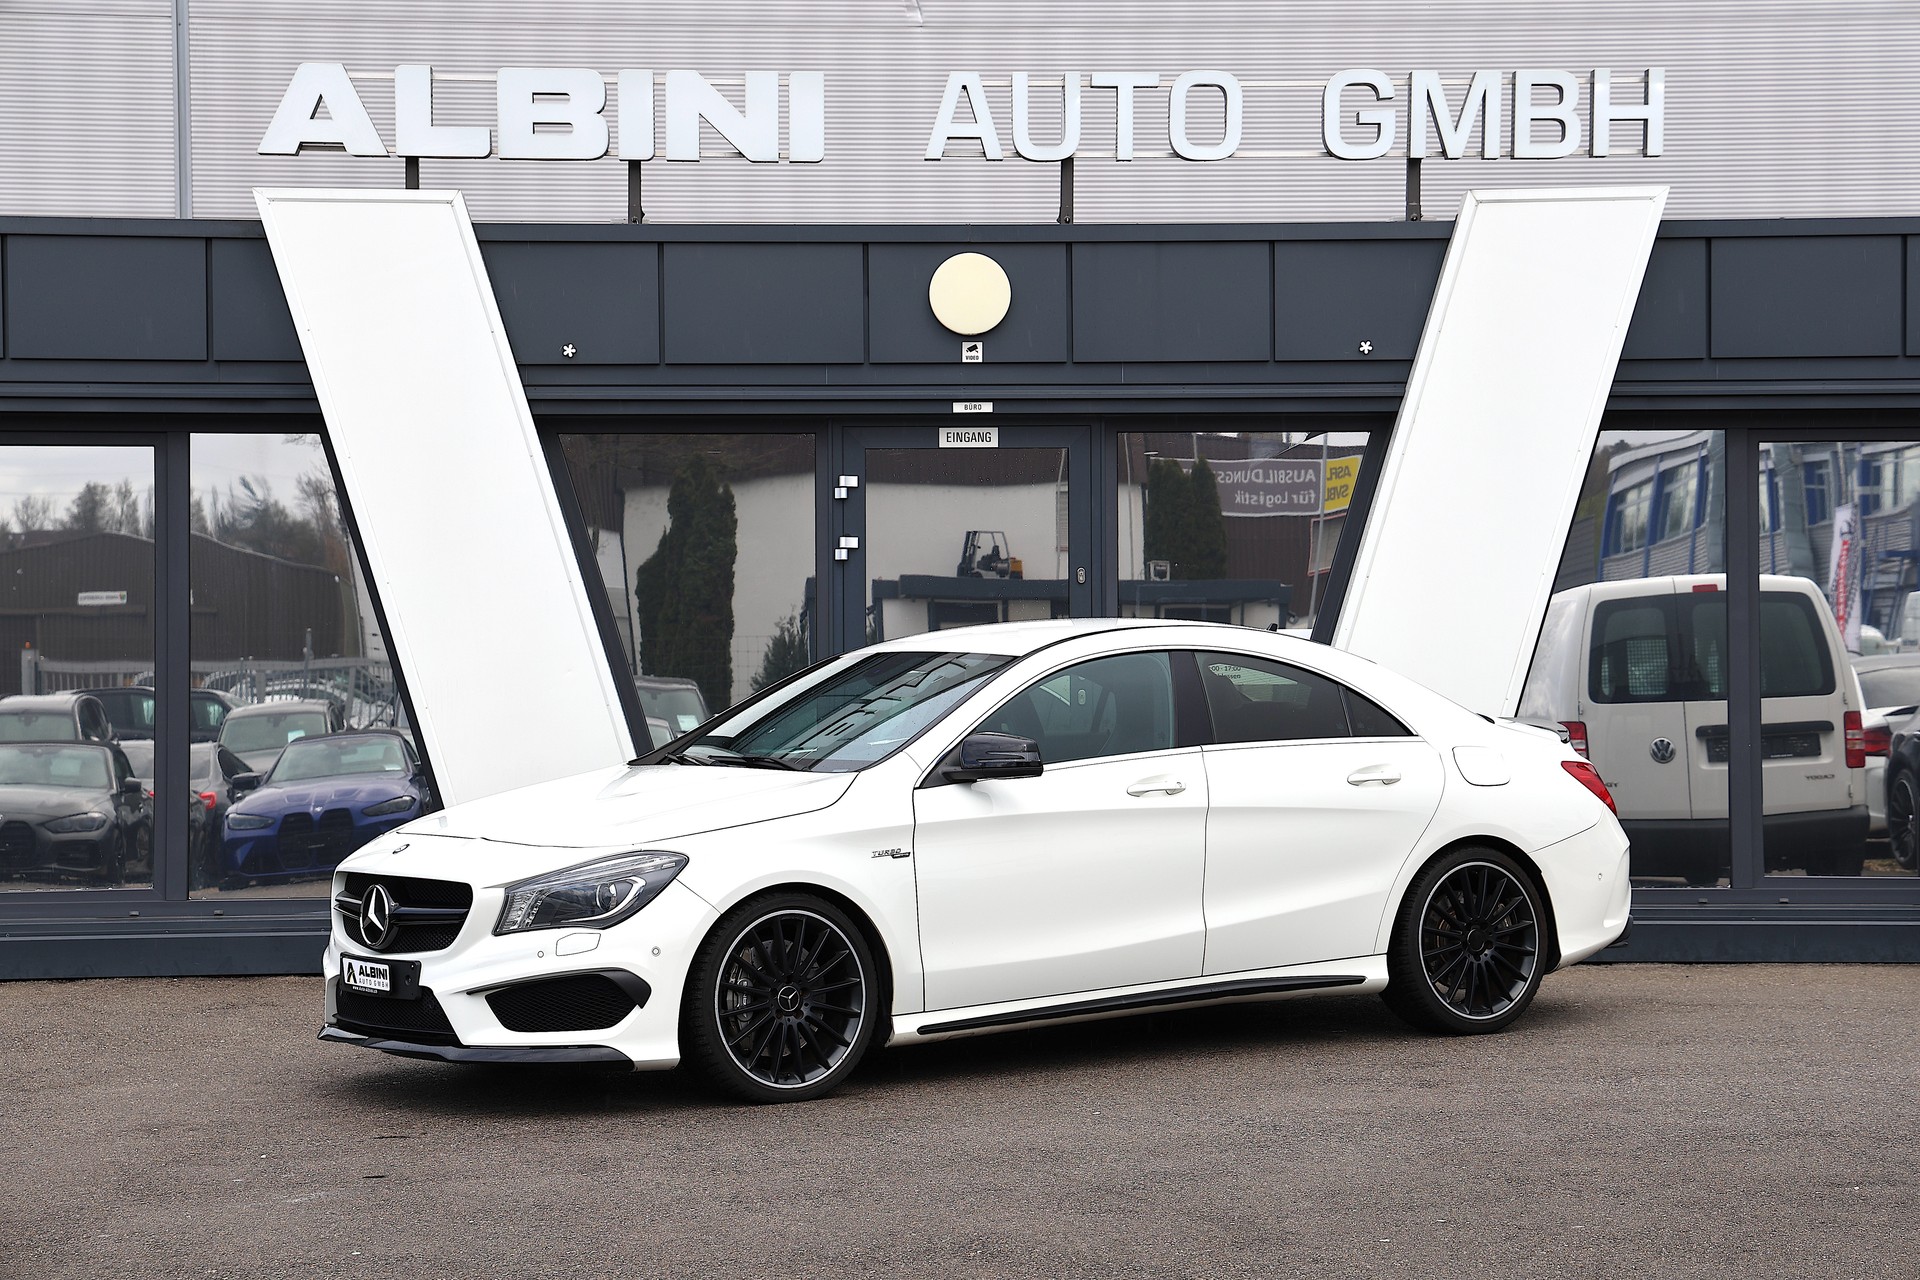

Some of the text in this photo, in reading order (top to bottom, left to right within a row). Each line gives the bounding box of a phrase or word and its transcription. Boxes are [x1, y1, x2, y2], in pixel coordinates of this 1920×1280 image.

[257, 62, 1665, 163] ALBINI AUTO GMBH
[964, 403, 982, 411] BÜRO
[946, 431, 992, 443] EINGANG
[358, 964, 388, 981] ALBINI
[359, 977, 372, 986] AUTO
